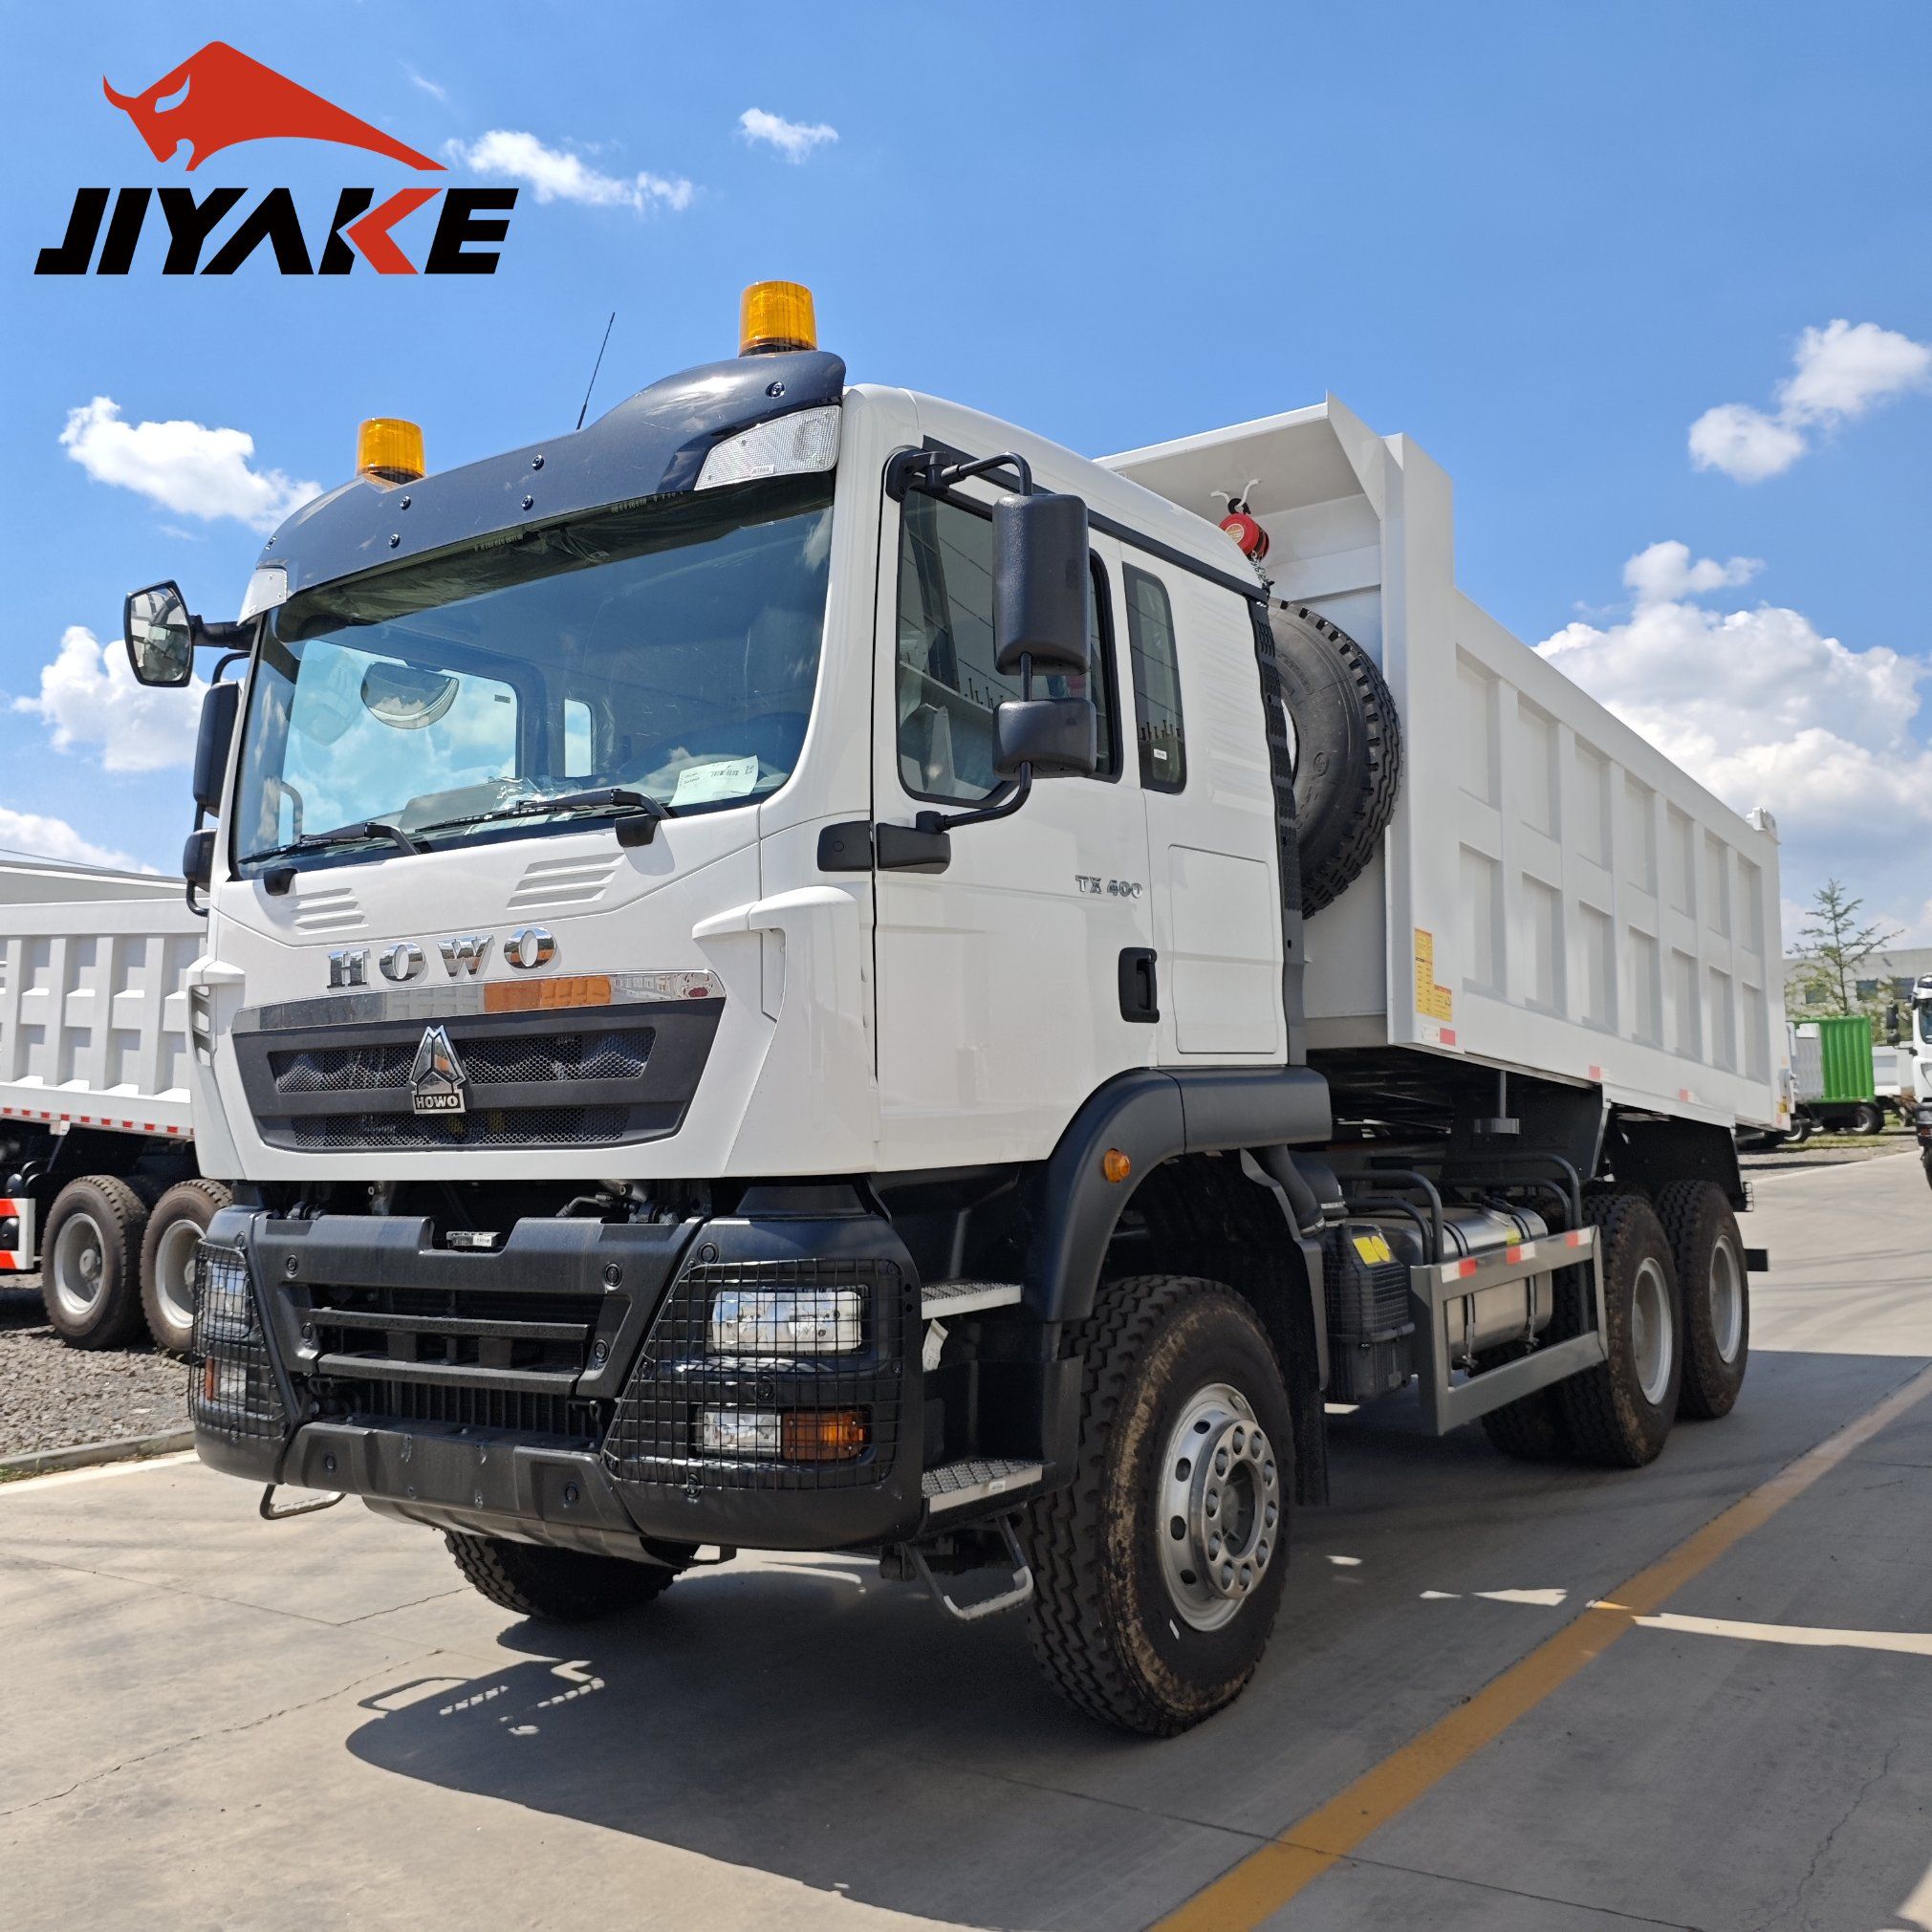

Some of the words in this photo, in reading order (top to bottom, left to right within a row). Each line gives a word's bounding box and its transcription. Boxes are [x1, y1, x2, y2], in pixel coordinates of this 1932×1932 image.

[1075, 875, 1102, 895] TX
[1106, 879, 1143, 900] 400
[327, 927, 558, 989] HOWO
[415, 1095, 459, 1109] HOWO
